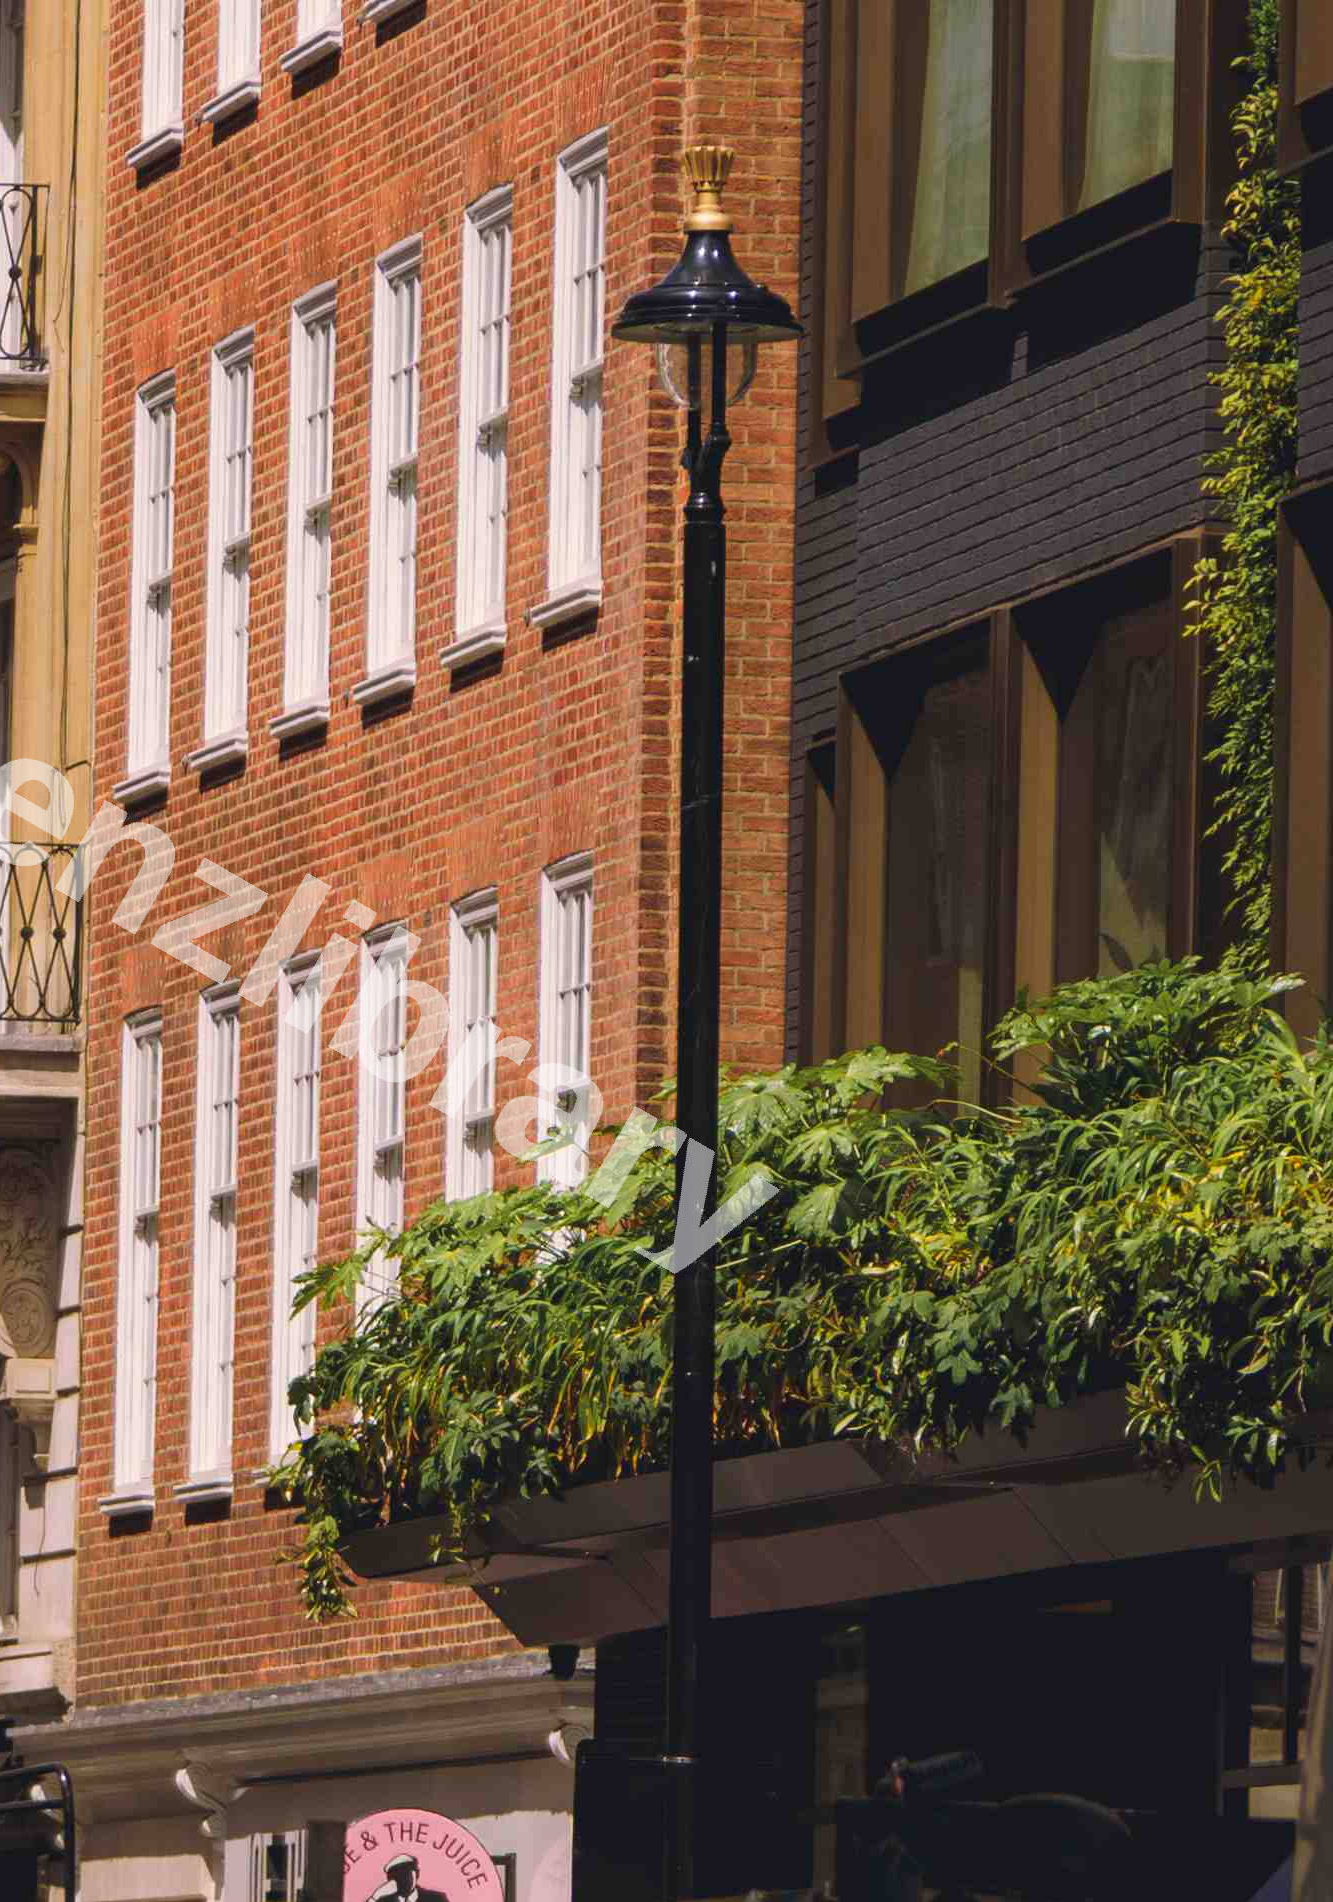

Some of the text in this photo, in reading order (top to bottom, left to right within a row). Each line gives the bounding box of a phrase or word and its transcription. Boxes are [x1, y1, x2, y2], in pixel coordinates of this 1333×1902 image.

[360, 1821, 488, 1889] & THE JUICE
